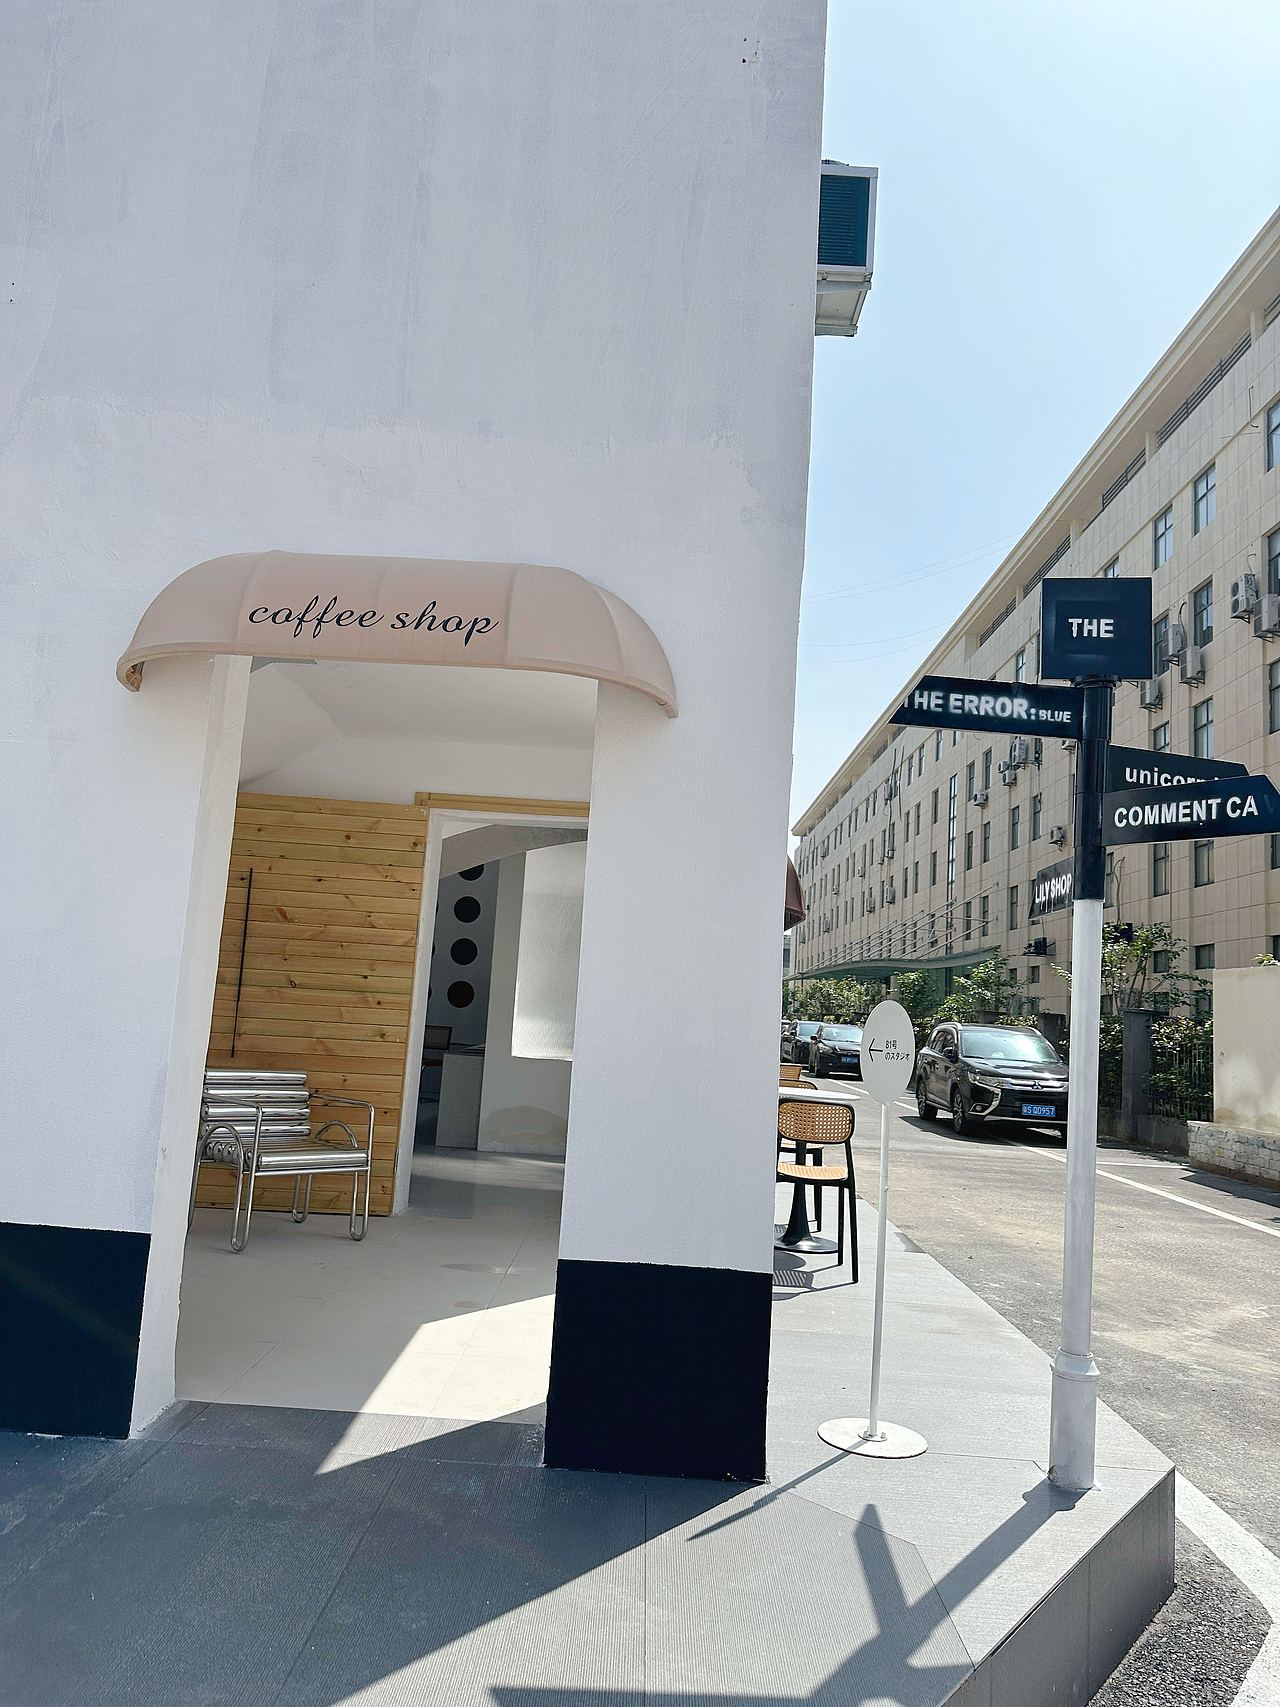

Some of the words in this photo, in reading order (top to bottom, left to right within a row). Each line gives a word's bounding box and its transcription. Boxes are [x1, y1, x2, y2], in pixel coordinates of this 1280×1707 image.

[248, 594, 385, 639] coffee
[390, 600, 500, 647] shop
[1068, 618, 1114, 638] THE
[1039, 709, 1072, 723] BLUE
[1125, 766, 1207, 787] unico
[1113, 798, 1222, 828] COMMENT
[1226, 795, 1259, 819] CA
[1035, 880, 1050, 904] LILY
[1050, 873, 1072, 898] SHOP
[885, 1039, 898, 1050] 81号
[884, 1051, 910, 1061] のスタジオ
